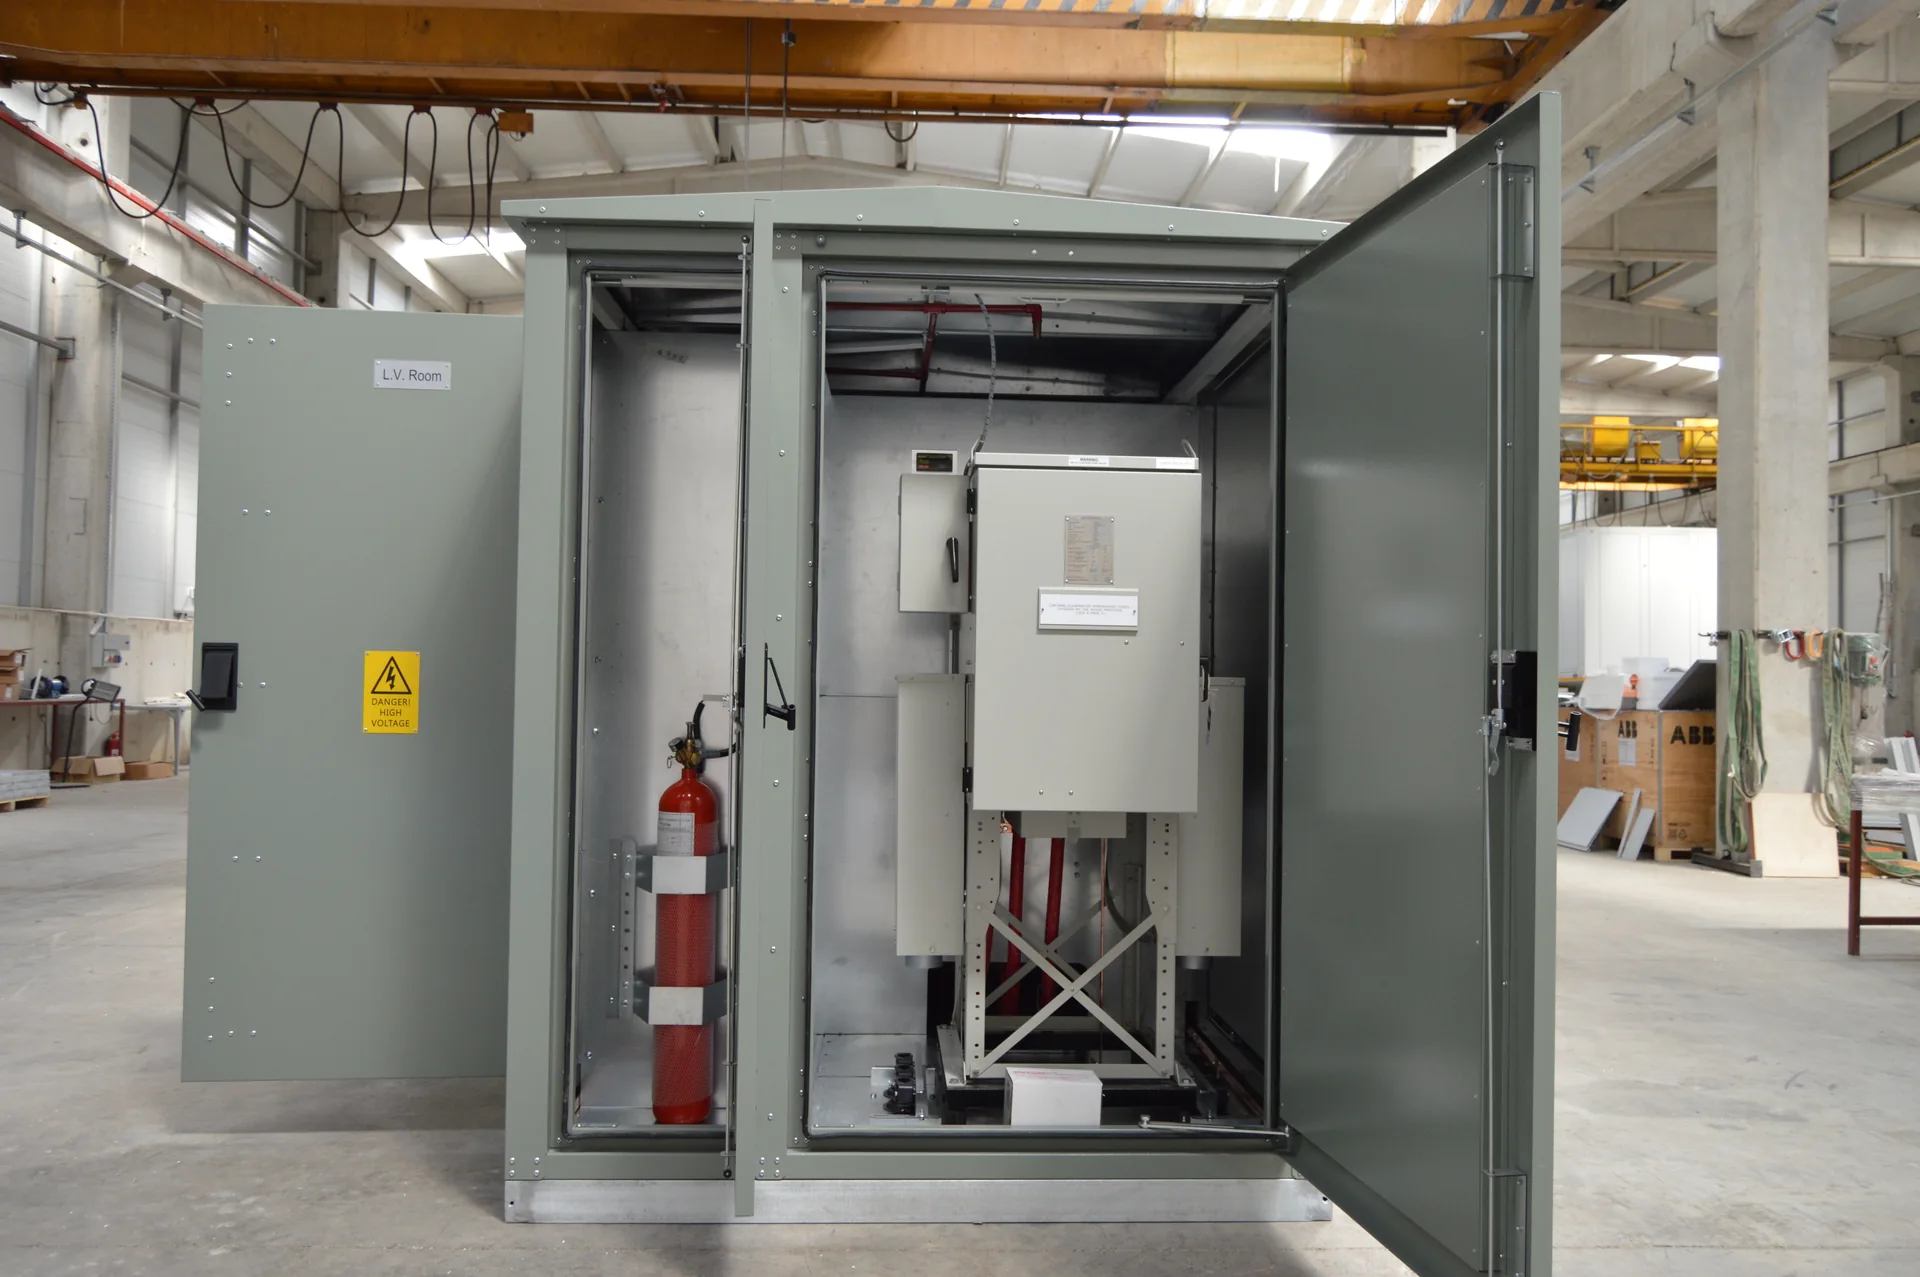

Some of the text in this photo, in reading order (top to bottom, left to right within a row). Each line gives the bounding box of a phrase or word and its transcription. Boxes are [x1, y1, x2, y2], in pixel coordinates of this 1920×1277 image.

[383, 368, 442, 382] L.V. Room
[371, 698, 411, 706] DANGER!
[371, 719, 411, 728] VOLTAGE
[1618, 720, 1638, 738] ABB
[1670, 725, 1716, 745] ABB
